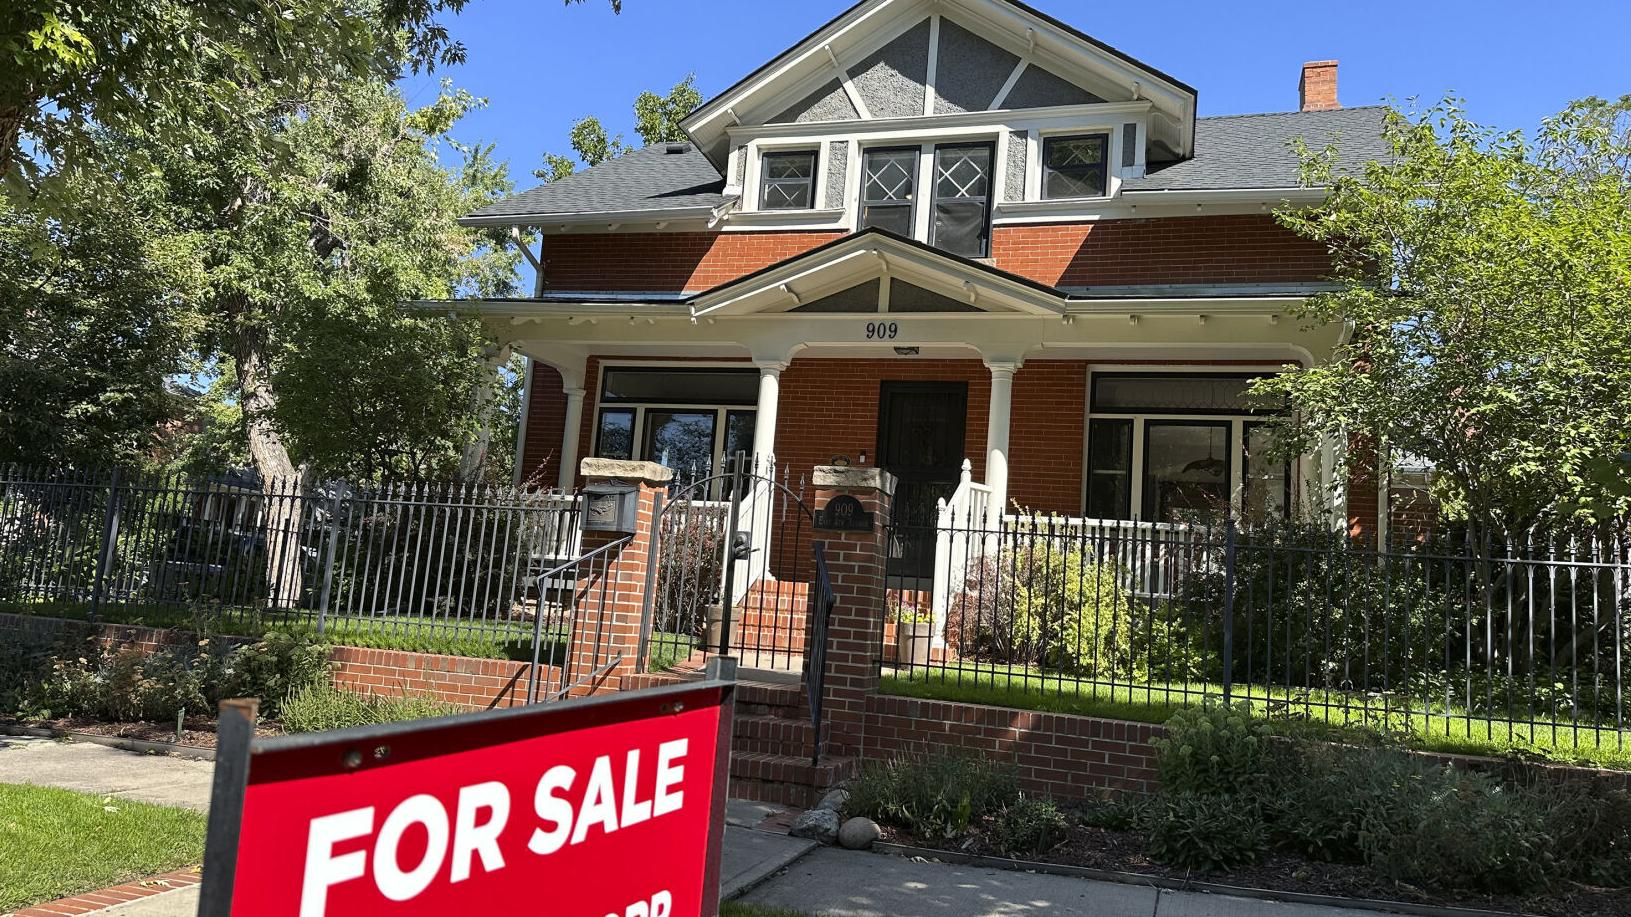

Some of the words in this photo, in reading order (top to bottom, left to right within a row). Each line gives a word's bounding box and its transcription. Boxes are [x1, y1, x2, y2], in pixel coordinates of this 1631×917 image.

[866, 322, 898, 339] 909
[299, 781, 511, 917] FOR
[527, 738, 689, 855] SALE
